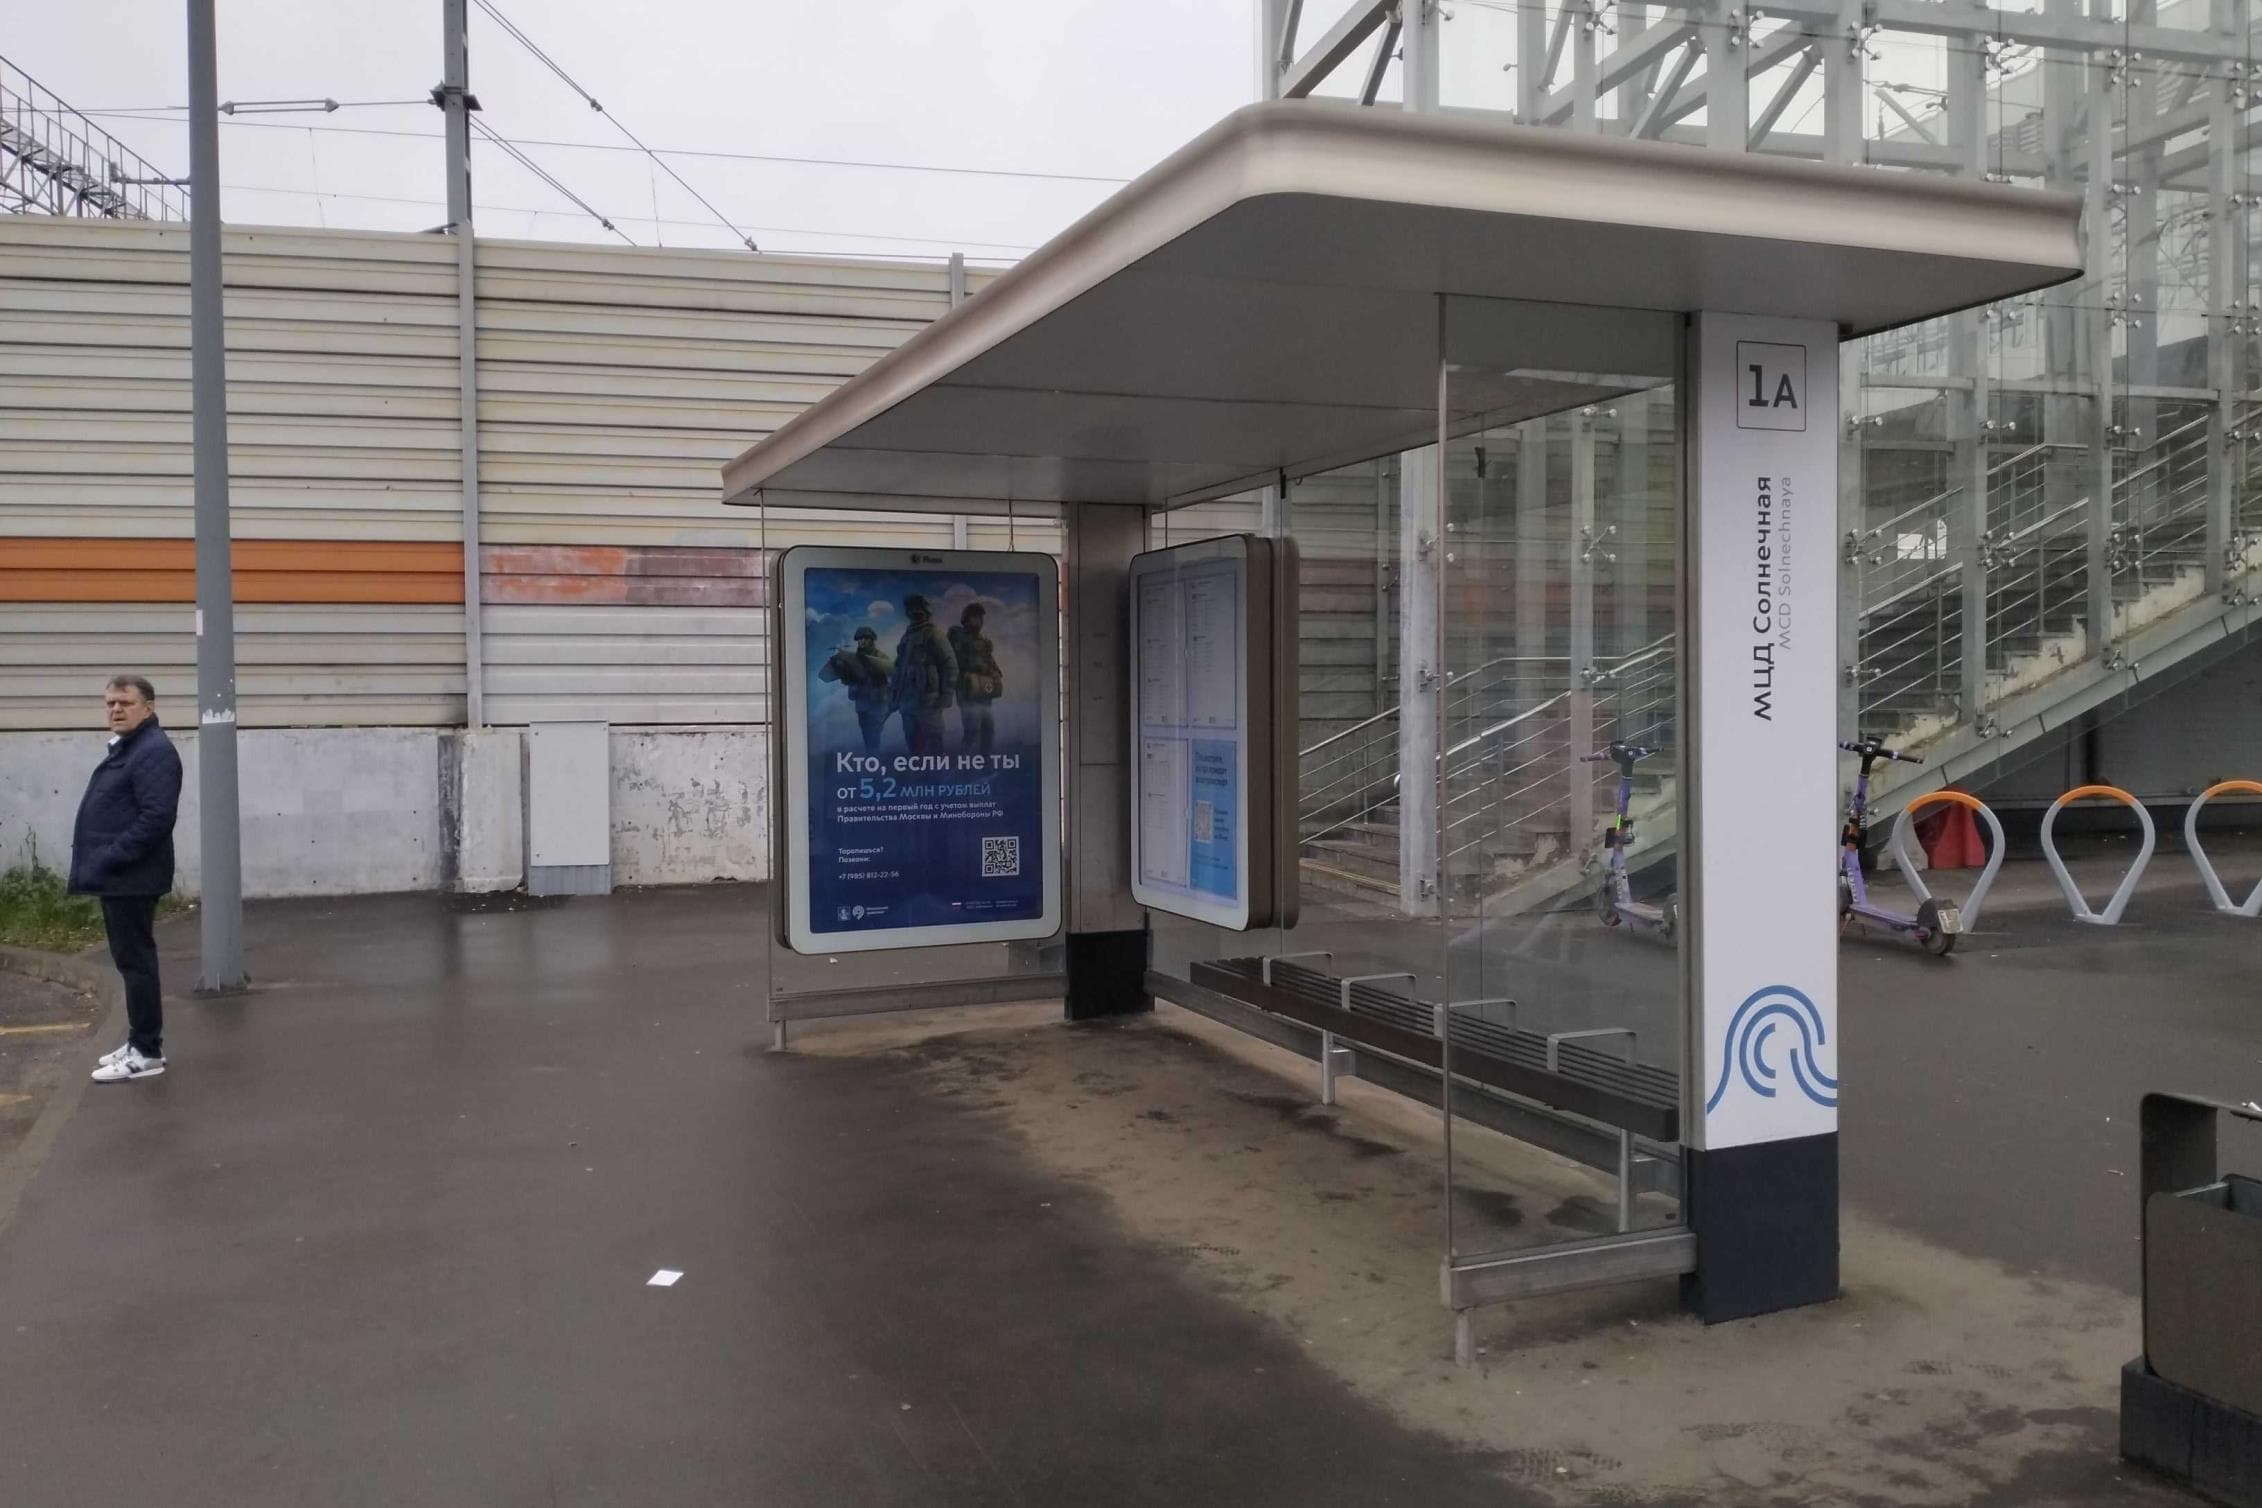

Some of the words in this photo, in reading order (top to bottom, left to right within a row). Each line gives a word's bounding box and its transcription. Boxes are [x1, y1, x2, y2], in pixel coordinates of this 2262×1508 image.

[1778, 476, 1794, 596] Solnechnaya
[1753, 477, 1772, 634] Солнечная
[1778, 602, 1792, 650] MCD
[1753, 643, 1775, 721] МЦД
[836, 752, 887, 776] Кто,
[893, 755, 950, 772] если
[957, 754, 985, 771] не
[990, 753, 1020, 770] ты
[836, 787, 857, 800] от
[859, 777, 897, 802] 5,2
[900, 785, 935, 798] МЛН
[938, 782, 992, 798] РУБЛЕЙ
[888, 802, 919, 813] первый
[919, 803, 934, 812] год
[837, 814, 898, 824] Правительства
[899, 812, 932, 821] Москвы
